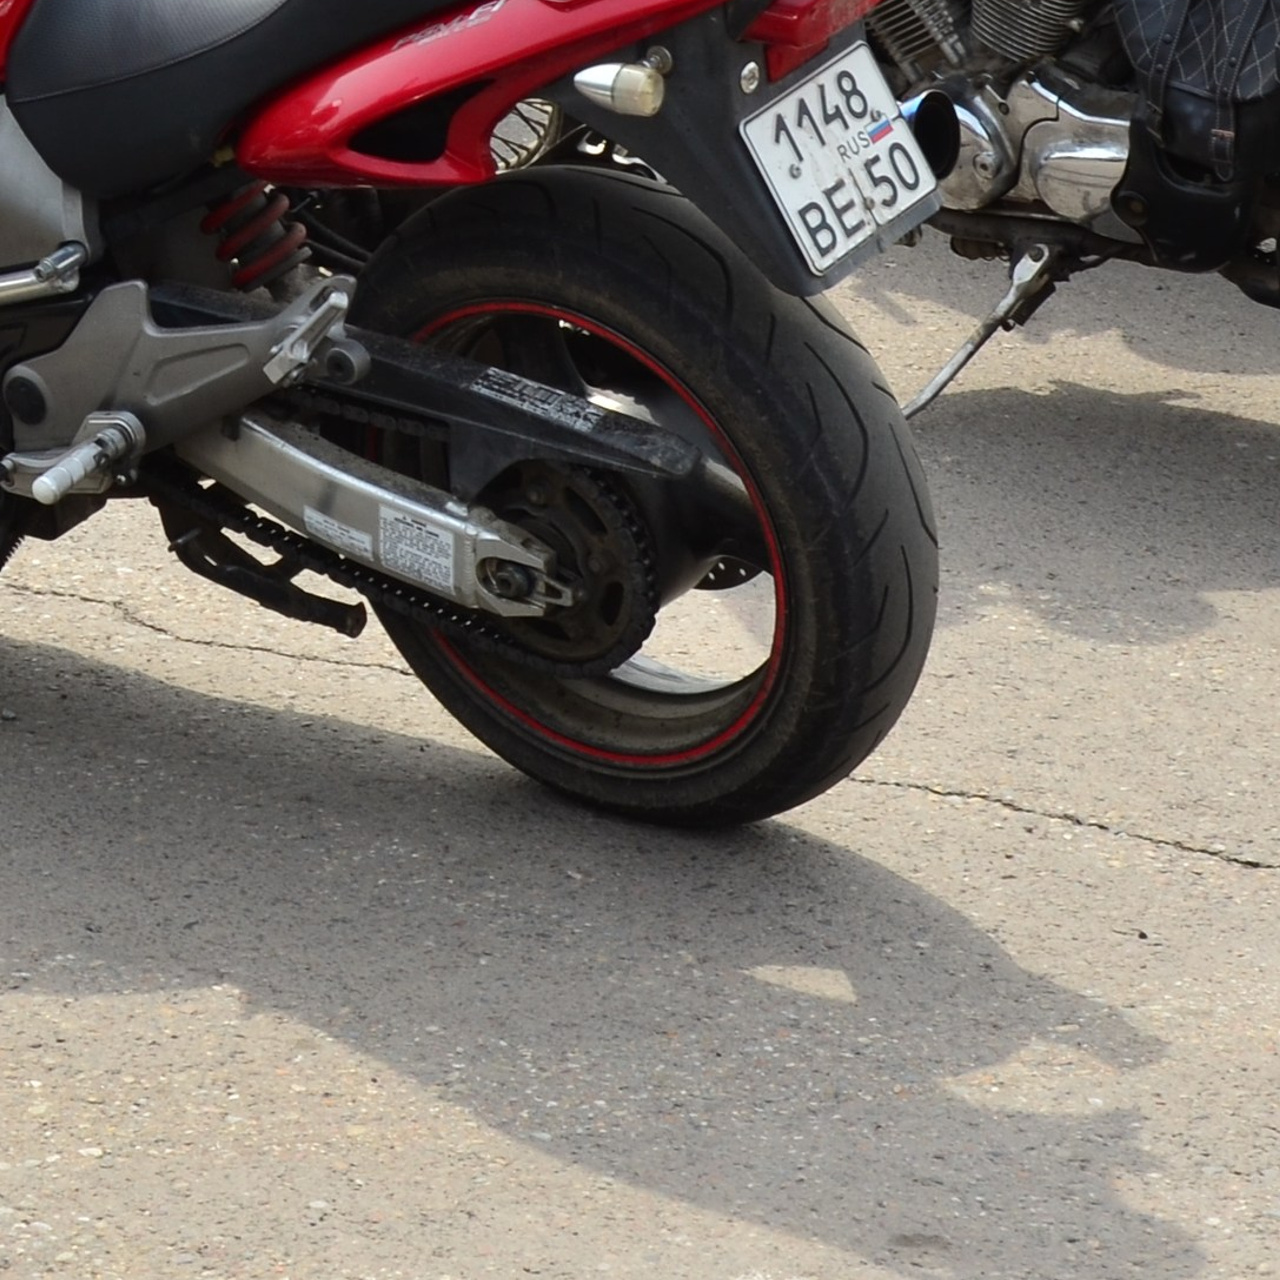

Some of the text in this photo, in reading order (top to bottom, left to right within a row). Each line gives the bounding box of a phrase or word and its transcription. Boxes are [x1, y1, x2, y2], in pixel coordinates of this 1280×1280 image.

[775, 70, 868, 162] 1148
[836, 130, 871, 163] RUS
[864, 142, 920, 208] 50
